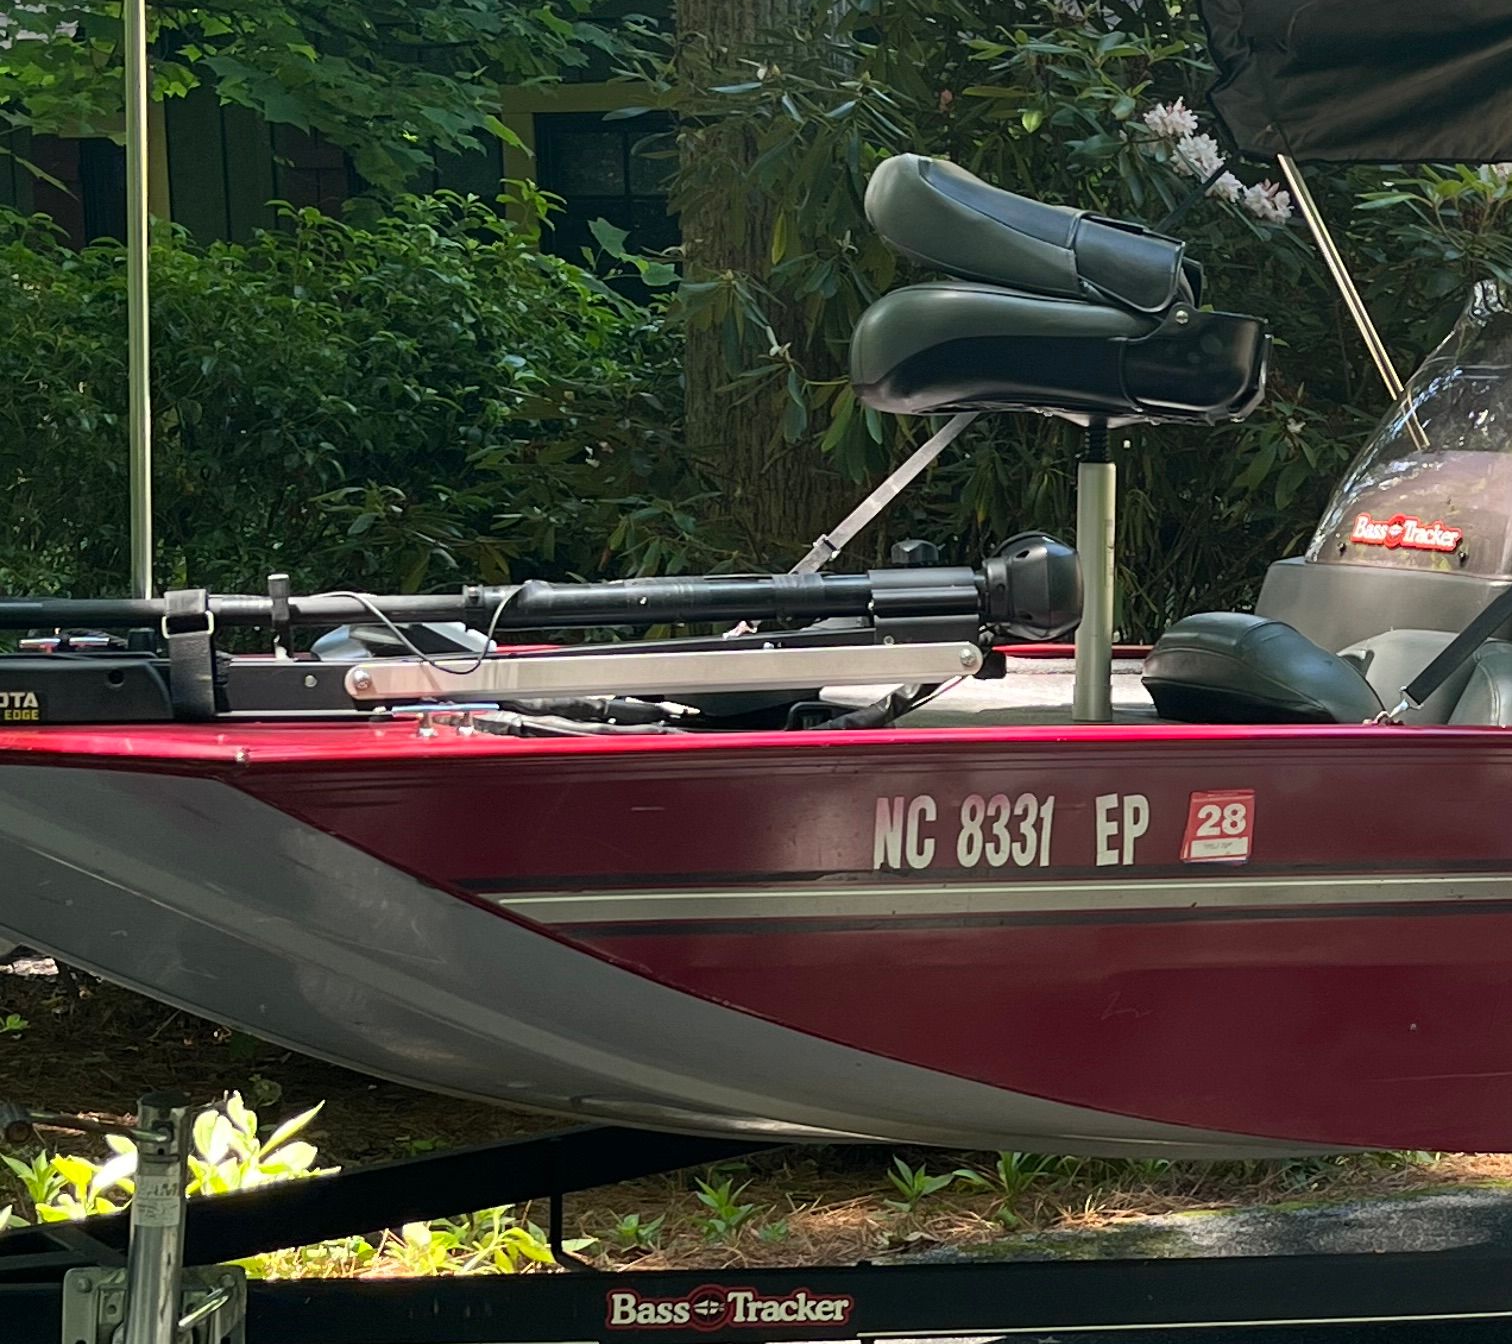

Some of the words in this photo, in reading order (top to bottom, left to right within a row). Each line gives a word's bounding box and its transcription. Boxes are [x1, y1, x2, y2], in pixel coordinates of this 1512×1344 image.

[1353, 516, 1388, 540] Bass
[1402, 519, 1459, 546] Tracker
[4, 709, 40, 721] EDGE
[873, 794, 937, 870] NC
[957, 792, 1055, 868] 8331
[1095, 793, 1150, 867] EP
[1196, 803, 1247, 837] 28
[610, 1293, 691, 1325] Bass
[727, 1292, 850, 1323] Tracker
